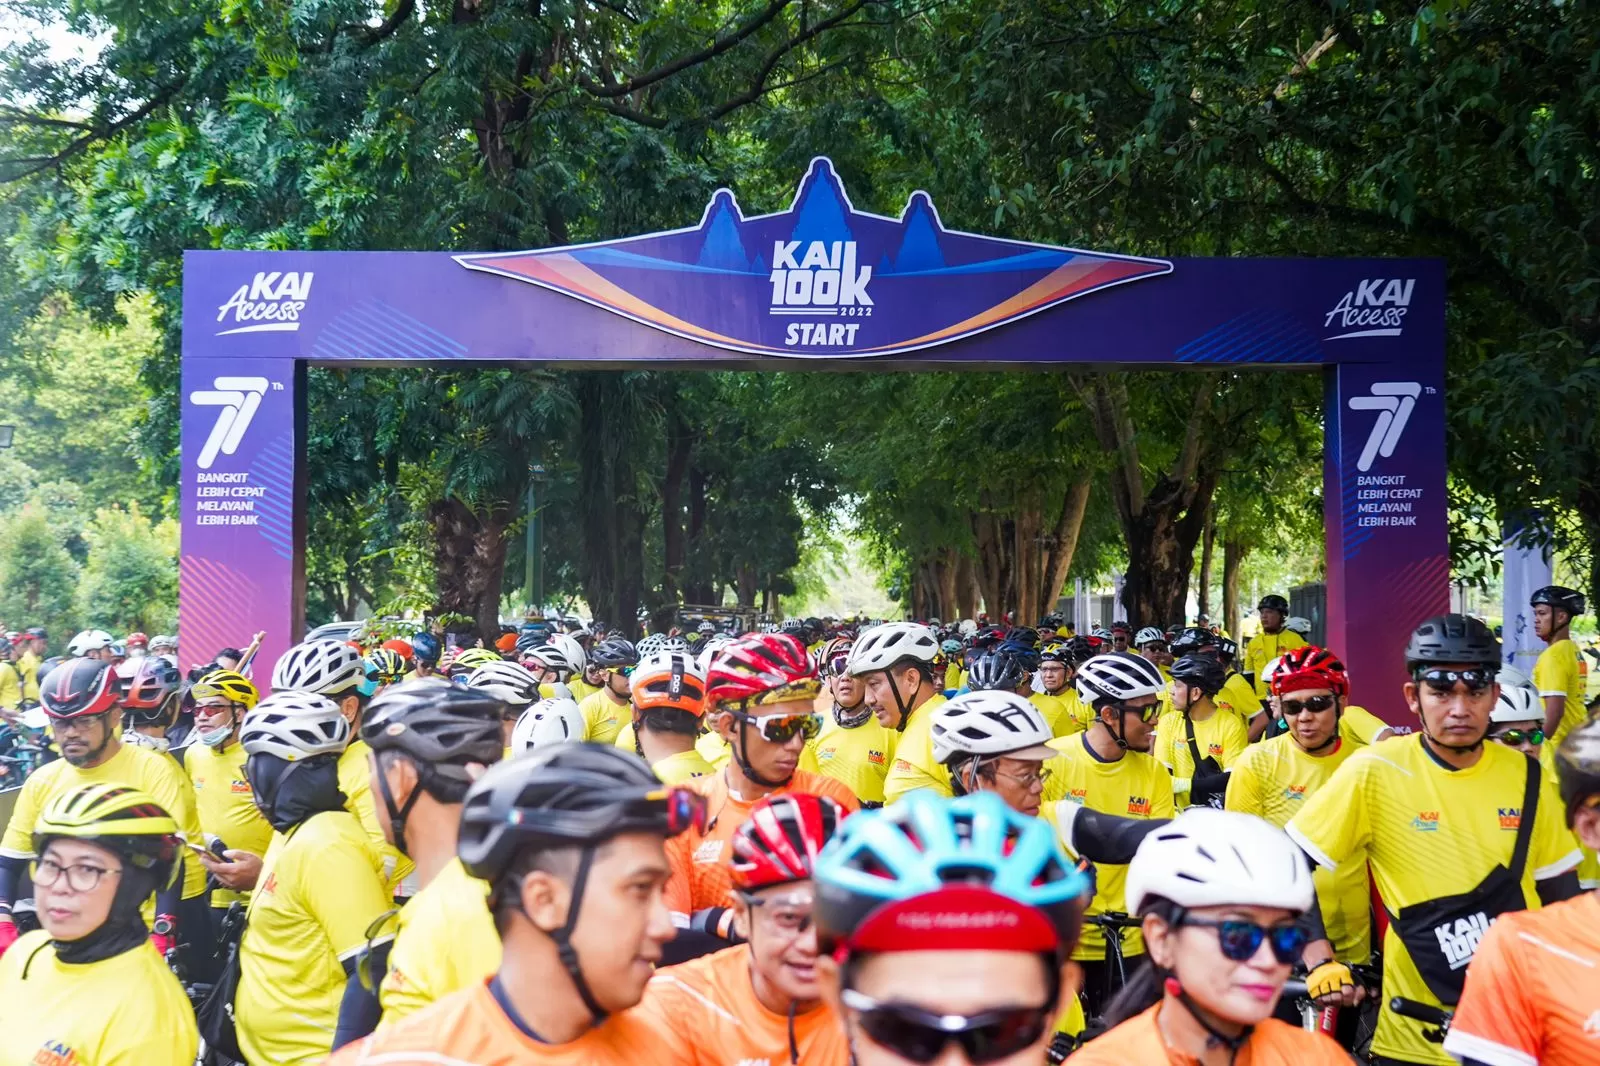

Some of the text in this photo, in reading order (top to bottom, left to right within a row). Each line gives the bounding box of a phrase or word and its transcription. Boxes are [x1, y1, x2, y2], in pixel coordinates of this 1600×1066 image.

[772, 240, 843, 270] KAI
[249, 271, 314, 300] KAI
[1354, 278, 1416, 306] KAI
[216, 284, 306, 322] Access
[840, 307, 872, 317] 2022
[1324, 291, 1408, 328] Access
[784, 322, 860, 346] START
[189, 376, 269, 469] 77
[1348, 381, 1422, 472] 77
[197, 472, 249, 483] BANGKIT
[1357, 475, 1406, 486] BANGKIT
[197, 486, 267, 497] LEBIH CEPAT
[1357, 488, 1424, 500] LEBIH CEPAT
[197, 501, 254, 511] MELAYANI
[1358, 502, 1413, 513] MELAYANI
[197, 514, 259, 525] LEBIH BAIK
[1358, 515, 1417, 527] LEBIH BAIK
[1129, 795, 1146, 804] KAI
[1419, 811, 1440, 821] KAI
[1498, 815, 1521, 829] 100
[1434, 914, 1482, 944] KAI
